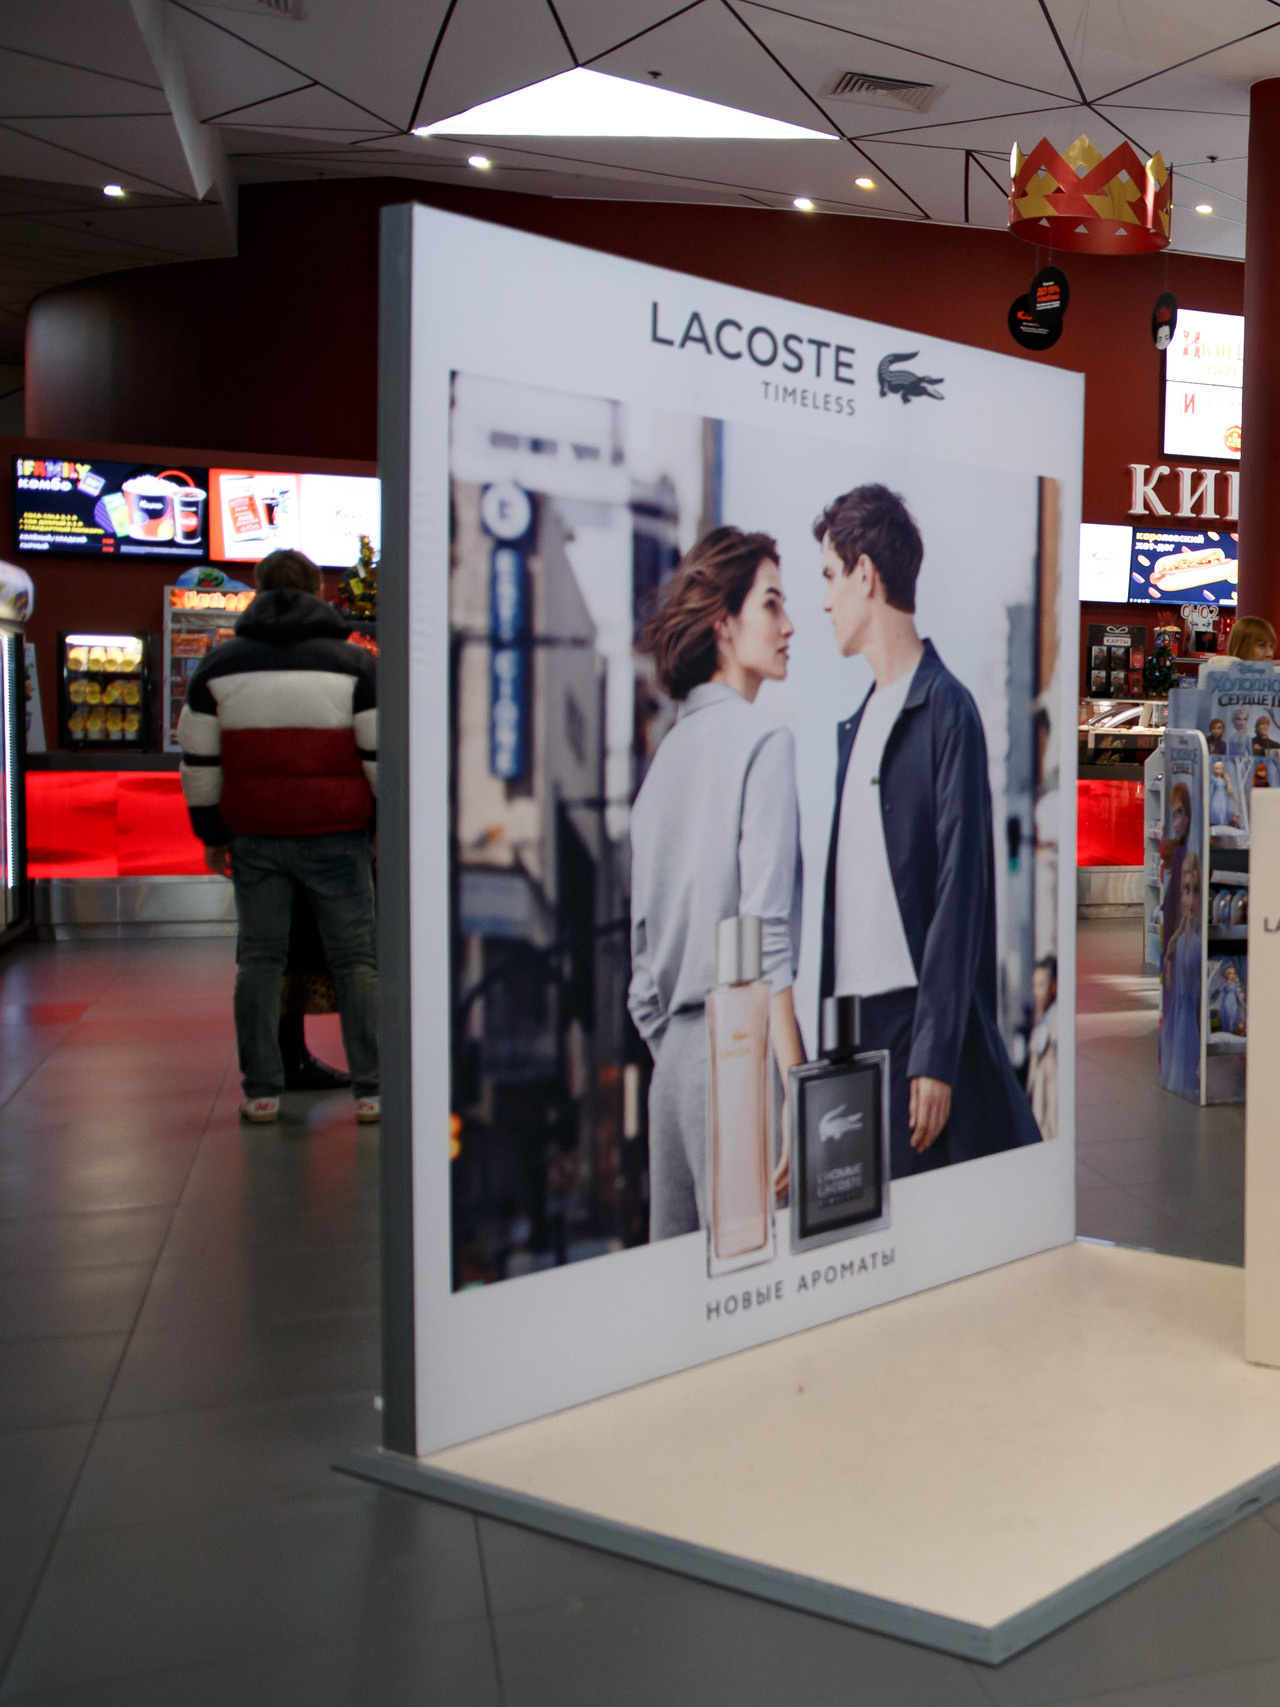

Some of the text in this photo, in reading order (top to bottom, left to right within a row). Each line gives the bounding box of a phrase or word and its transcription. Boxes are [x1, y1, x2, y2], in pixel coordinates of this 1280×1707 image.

[651, 301, 855, 385] LACOSTE
[762, 381, 855, 416] TIMELESS
[22, 460, 92, 480] FAMILY
[1218, 693, 1269, 707] СЕРДЦЕ
[706, 1247, 896, 1321] НОВЫЕ АРОМАТЫ
